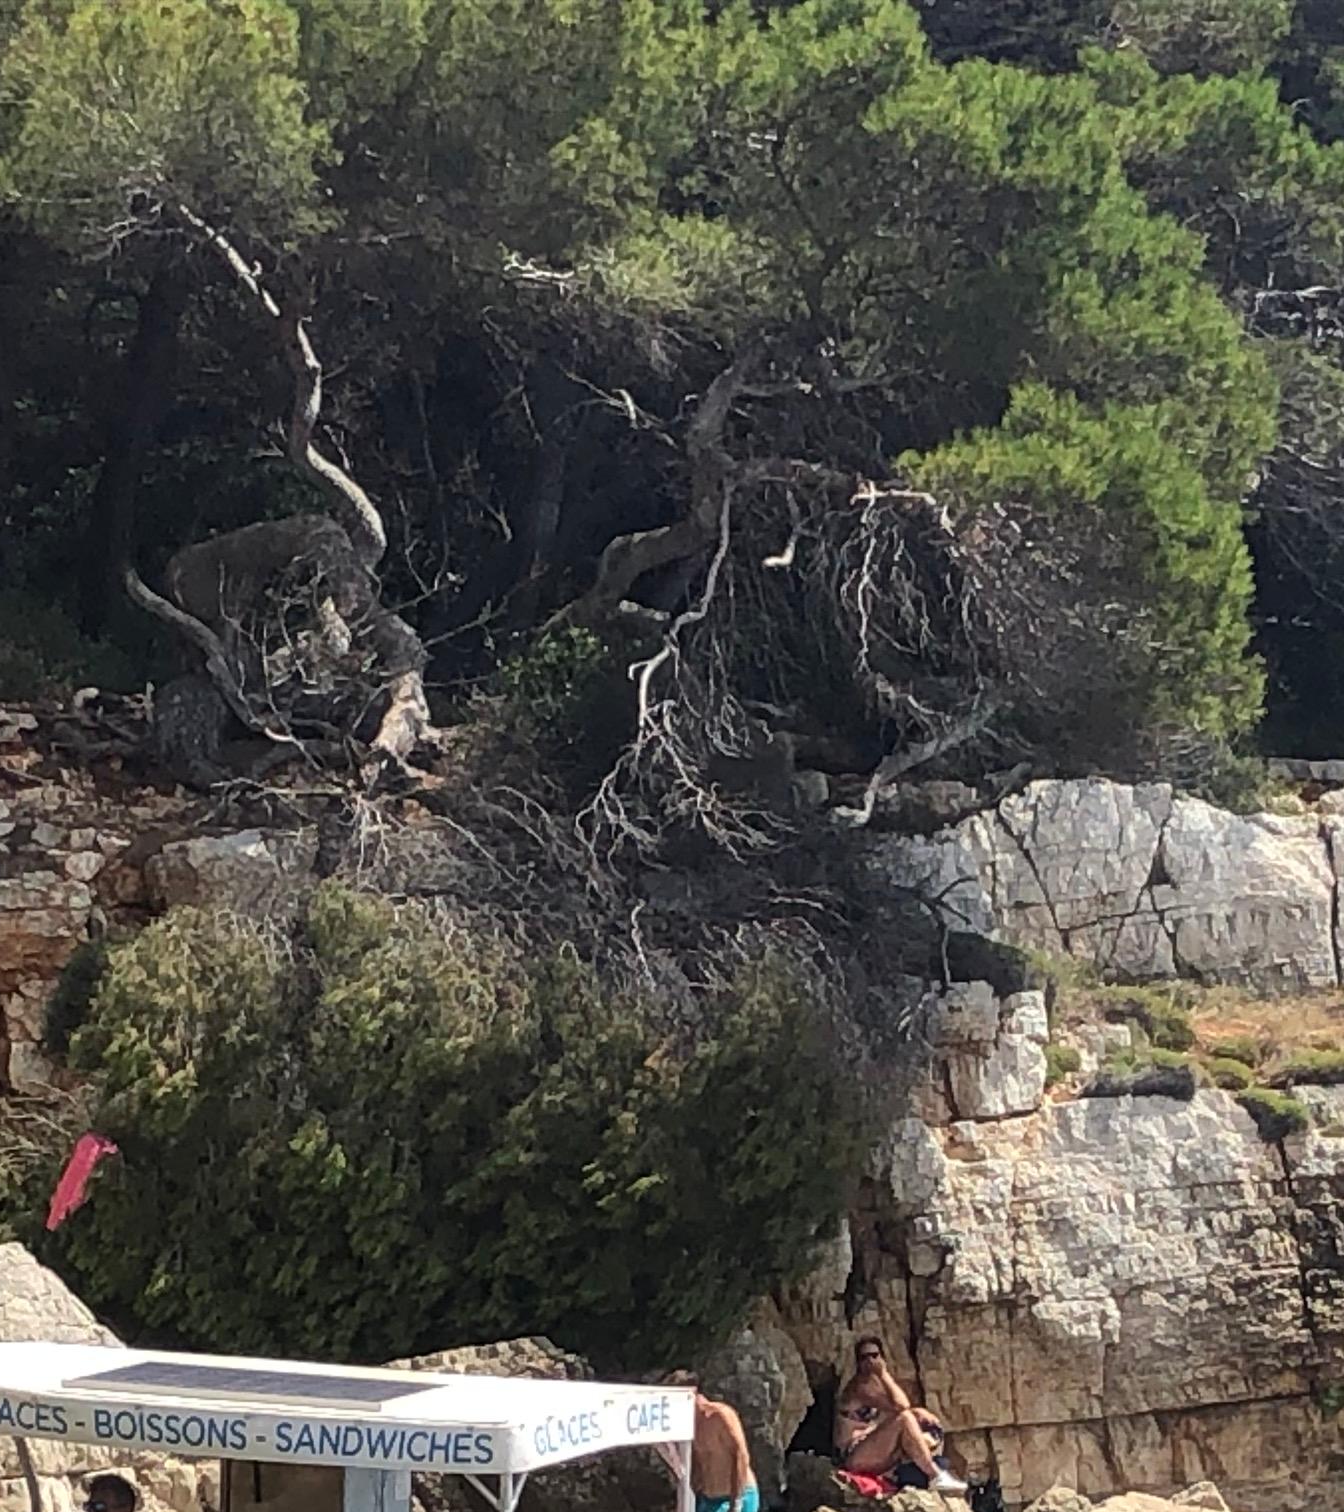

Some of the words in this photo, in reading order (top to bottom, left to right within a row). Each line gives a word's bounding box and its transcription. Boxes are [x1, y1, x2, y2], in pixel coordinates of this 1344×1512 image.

[94, 1408, 247, 1451] BOISSONS
[275, 1421, 494, 1465] SANDWICHES
[533, 1412, 603, 1456] GLACES
